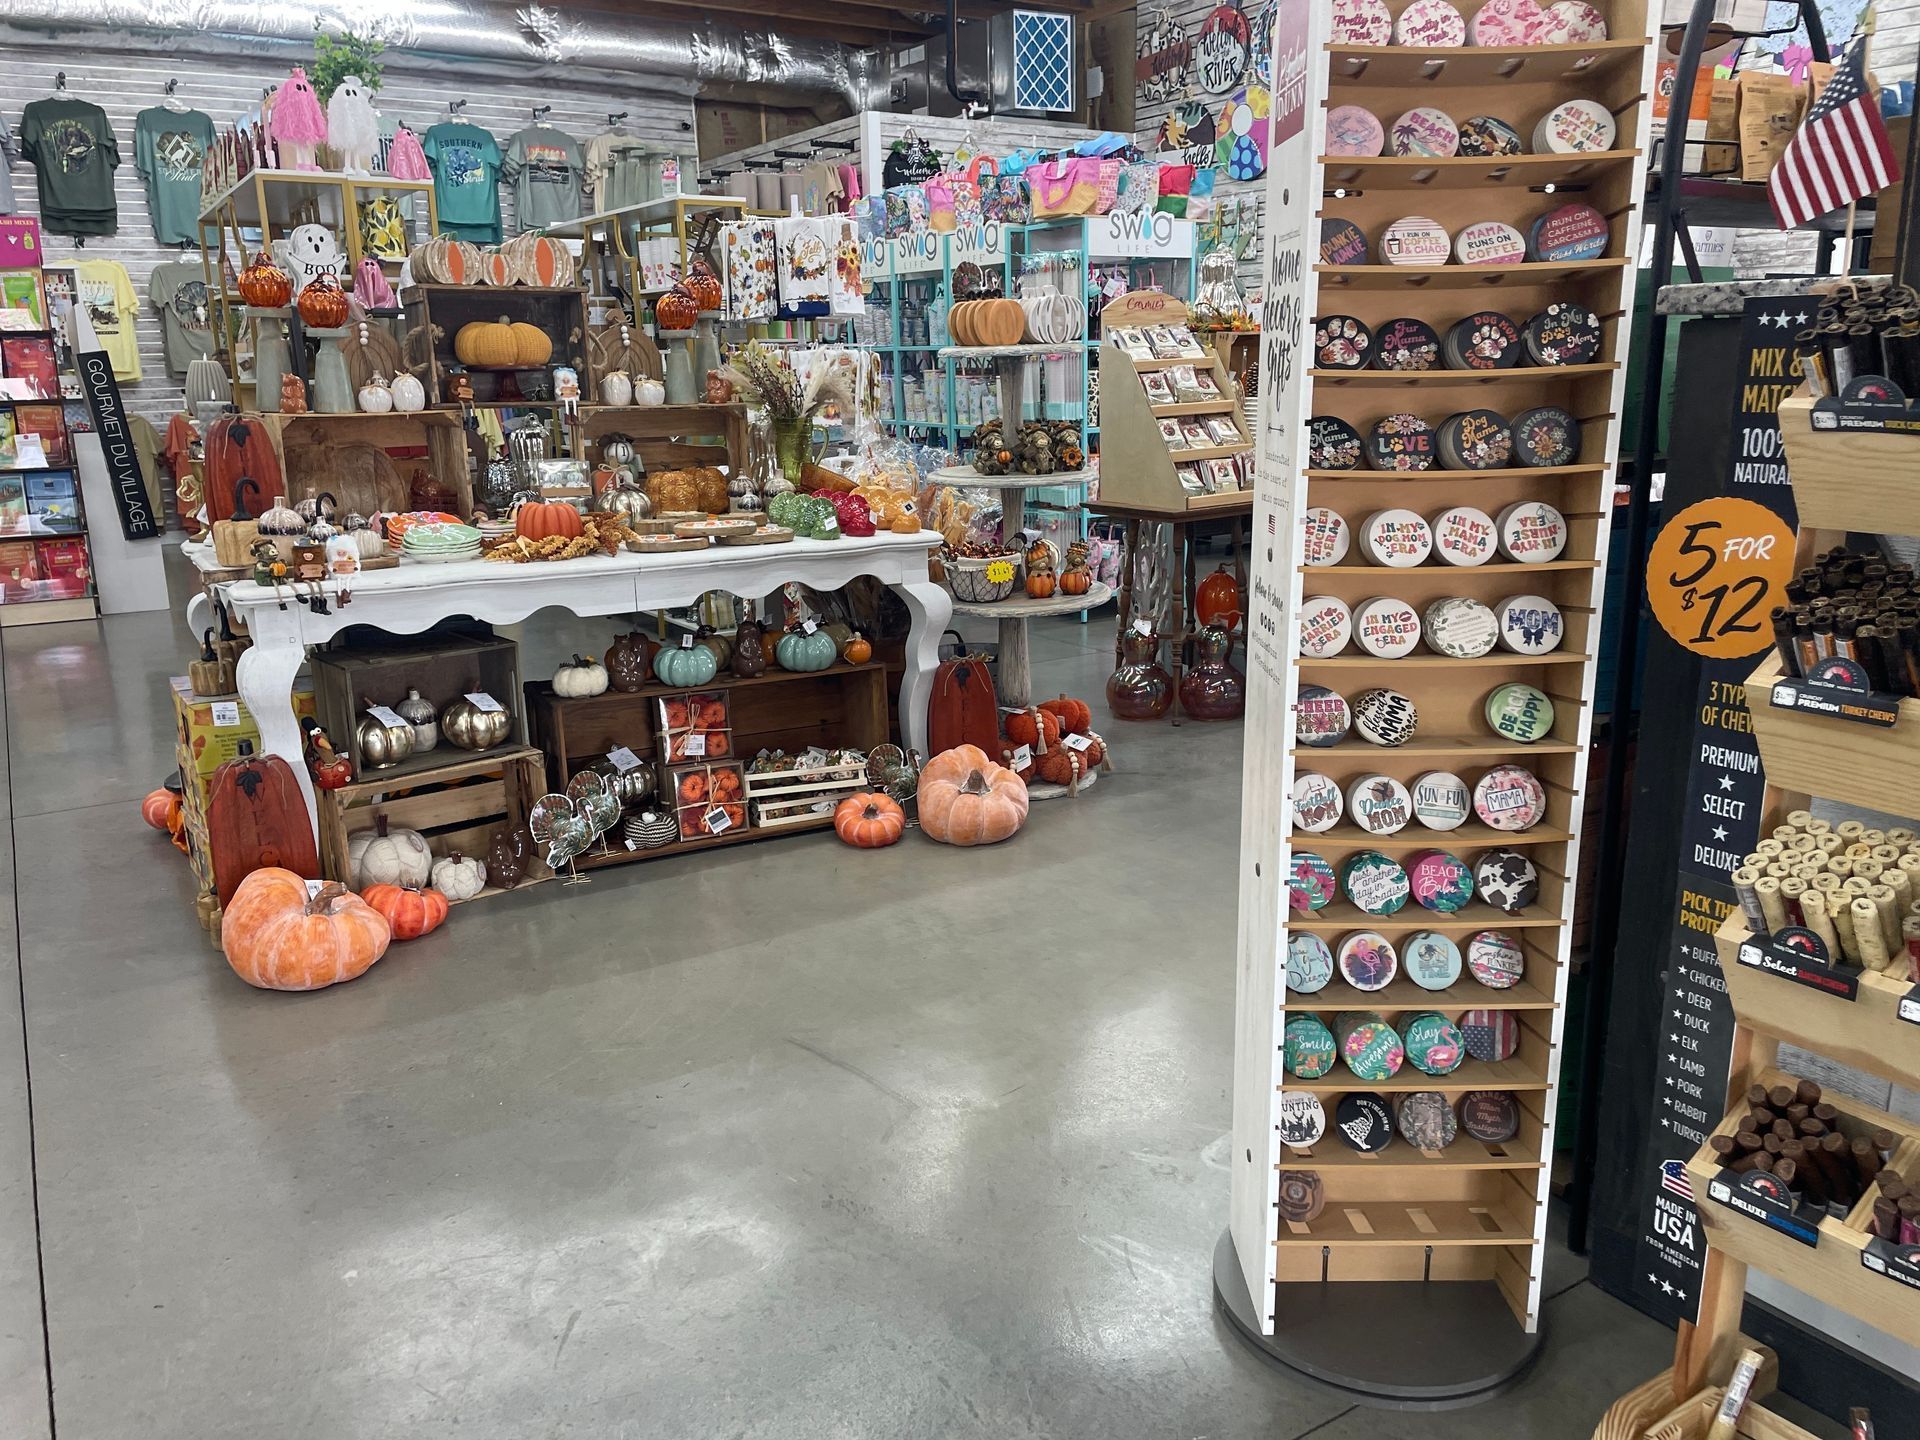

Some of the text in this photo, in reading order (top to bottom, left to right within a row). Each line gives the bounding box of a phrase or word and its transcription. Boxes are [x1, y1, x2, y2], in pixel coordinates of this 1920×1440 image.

[1334, 13, 1383, 29] Pretty in
[1406, 14, 1451, 38] Pretty in
[1345, 28, 1373, 41] Pink
[1423, 28, 1449, 46] Pink
[1410, 111, 1457, 144] BEACH
[1552, 113, 1581, 132] SOFT
[440, 138, 483, 150] SOUTHERN
[1581, 129, 1604, 147] GIRL
[895, 163, 938, 177] welcome
[1110, 206, 1172, 247] swig
[1552, 216, 1572, 228] RUN
[1574, 210, 1590, 221] ON
[956, 215, 998, 255] swig
[1404, 237, 1441, 246] COFFEE
[1466, 225, 1506, 241] MAMA
[1467, 234, 1511, 249] RUNS ON
[1547, 229, 1592, 248] SARCASM
[900, 227, 937, 261] swig
[1404, 244, 1448, 255] & CHAOS
[1466, 241, 1520, 261] COFFEE
[1574, 239, 1606, 254] Words
[304, 264, 337, 276] BOO
[1271, 234, 1301, 287] home
[1394, 321, 1418, 338] Fur
[1474, 315, 1518, 344] DOG MOM
[1544, 311, 1584, 331] In My
[1384, 333, 1427, 351] Mama
[1567, 333, 1597, 348] Mom
[1464, 350, 1496, 370] VIBES
[1751, 348, 1805, 377] MIX &
[1267, 337, 1293, 413] gifts
[87, 358, 124, 441] GOURMET
[1313, 420, 1340, 435] Cat
[1462, 415, 1488, 431] Dog
[1520, 411, 1569, 440] ANTISOCIAL
[1310, 431, 1349, 448] Mama
[1461, 424, 1499, 449] Mama
[110, 443, 131, 468] DU
[1734, 463, 1792, 485] NATURAL
[119, 469, 149, 533] VILLAGE
[1381, 522, 1418, 534] IN MY
[1451, 515, 1491, 536] IN MY
[1519, 515, 1546, 528] ERA
[1312, 510, 1329, 562] TEACHER
[1324, 526, 1339, 552] ERA
[1378, 534, 1426, 544] DOG MOM
[1449, 526, 1487, 547] MAMA
[1512, 524, 1558, 541] NURSE
[1390, 543, 1418, 555] ERA
[1452, 540, 1478, 558] ERA
[1542, 537, 1557, 550] IN
[1669, 521, 1776, 587] 5 FOR
[1308, 610, 1326, 628] MY
[1365, 612, 1399, 626] IN MY
[1681, 576, 1769, 643] $12
[1300, 611, 1345, 648] MARRIED
[1363, 622, 1418, 637] ENGAGED
[1507, 608, 1560, 637] MOM
[1318, 628, 1342, 646] ERA
[1383, 635, 1407, 645] ERA
[1709, 681, 1718, 701] 3
[1296, 699, 1344, 713] CHEER
[1362, 698, 1388, 734] blessed
[1515, 692, 1545, 739] HAPPY
[1702, 705, 1719, 726] OF
[1797, 698, 1840, 713] PREMIUM
[1868, 709, 1896, 722] CHEWS
[1378, 695, 1410, 743] MAMA
[1700, 744, 1760, 775] PREMIUM
[1359, 797, 1404, 817] Dance
[1416, 784, 1468, 811] SUN FUN
[1489, 789, 1521, 810] MAMA
[1702, 794, 1745, 820] SELECT
[1366, 805, 1409, 831] MOM
[1694, 843, 1741, 873] DELUXE
[1350, 868, 1372, 887] just
[1362, 865, 1400, 887] another
[1421, 864, 1463, 878] BEACH
[1355, 882, 1385, 900] day in
[1364, 883, 1409, 910] paradise
[1682, 890, 1711, 914] PICK
[1763, 956, 1797, 976] Select
[1688, 992, 1712, 1011] DEER
[1684, 1013, 1710, 1034] DUCK
[1298, 1036, 1334, 1051] Smile
[1681, 1035, 1699, 1052] ELK
[1355, 1035, 1396, 1076] Awesome
[1679, 1056, 1706, 1077] LAMB
[1677, 1078, 1703, 1099] PORK
[1370, 1102, 1386, 1118] TREAD
[1674, 1099, 1708, 1124] RABBIT
[1672, 1120, 1709, 1144] TURKEY
[1656, 1194, 1697, 1225] MADE IN
[1731, 1196, 1768, 1220] DELUXE
[1654, 1207, 1694, 1252] USA
[1645, 1235, 1700, 1269] FROM AMERICAN
[1660, 1251, 1682, 1268] FARMS
